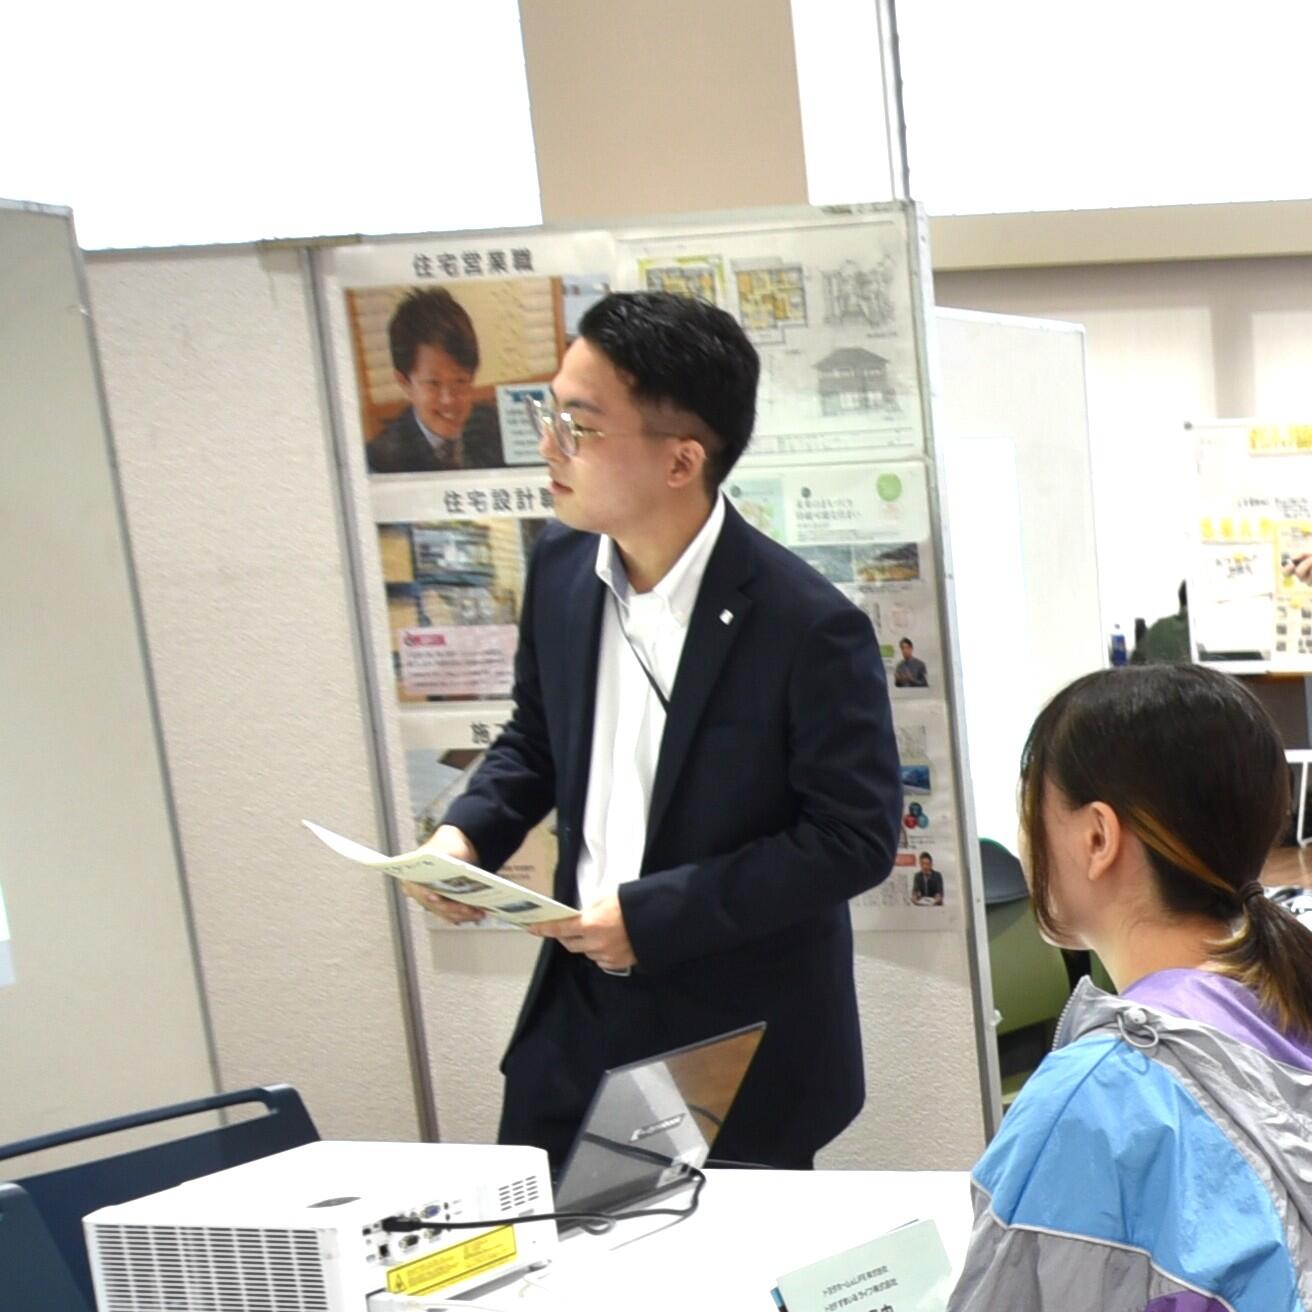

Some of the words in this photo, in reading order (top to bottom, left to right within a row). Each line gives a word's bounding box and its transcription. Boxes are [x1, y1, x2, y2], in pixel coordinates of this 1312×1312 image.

[412, 247, 534, 278] 住宅営業職
